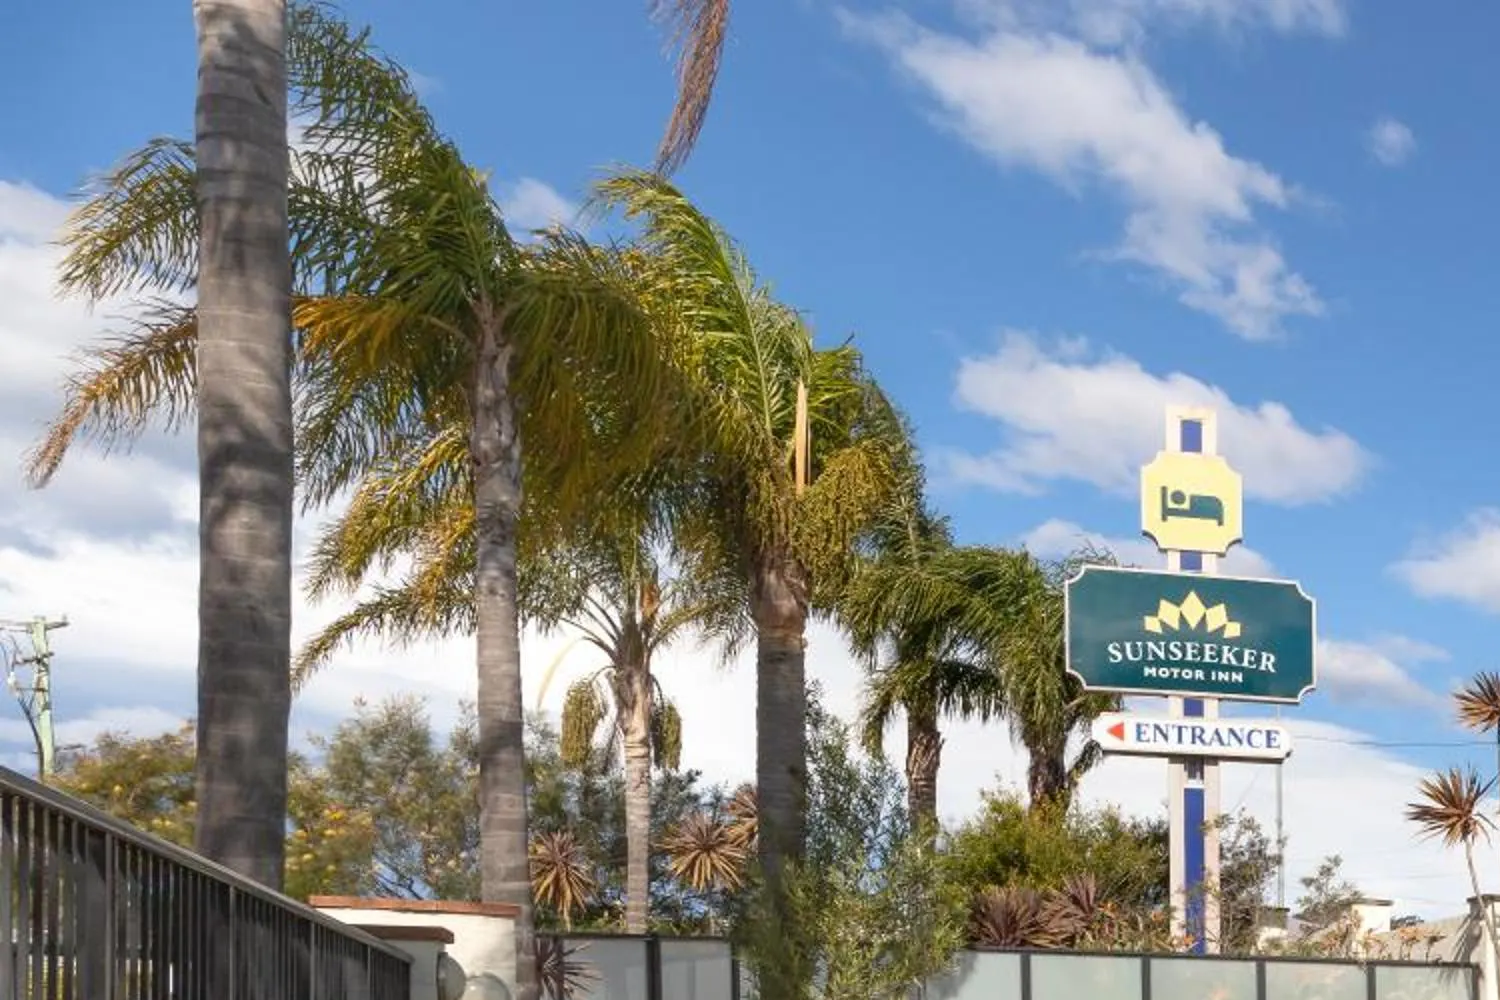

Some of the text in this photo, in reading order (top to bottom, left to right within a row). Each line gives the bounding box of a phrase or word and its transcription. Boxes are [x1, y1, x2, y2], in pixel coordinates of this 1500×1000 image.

[1107, 640, 1276, 673] SUNSEEKER
[1143, 666, 1243, 683] MOTOR INN
[1135, 722, 1281, 749] ENTRANCE
